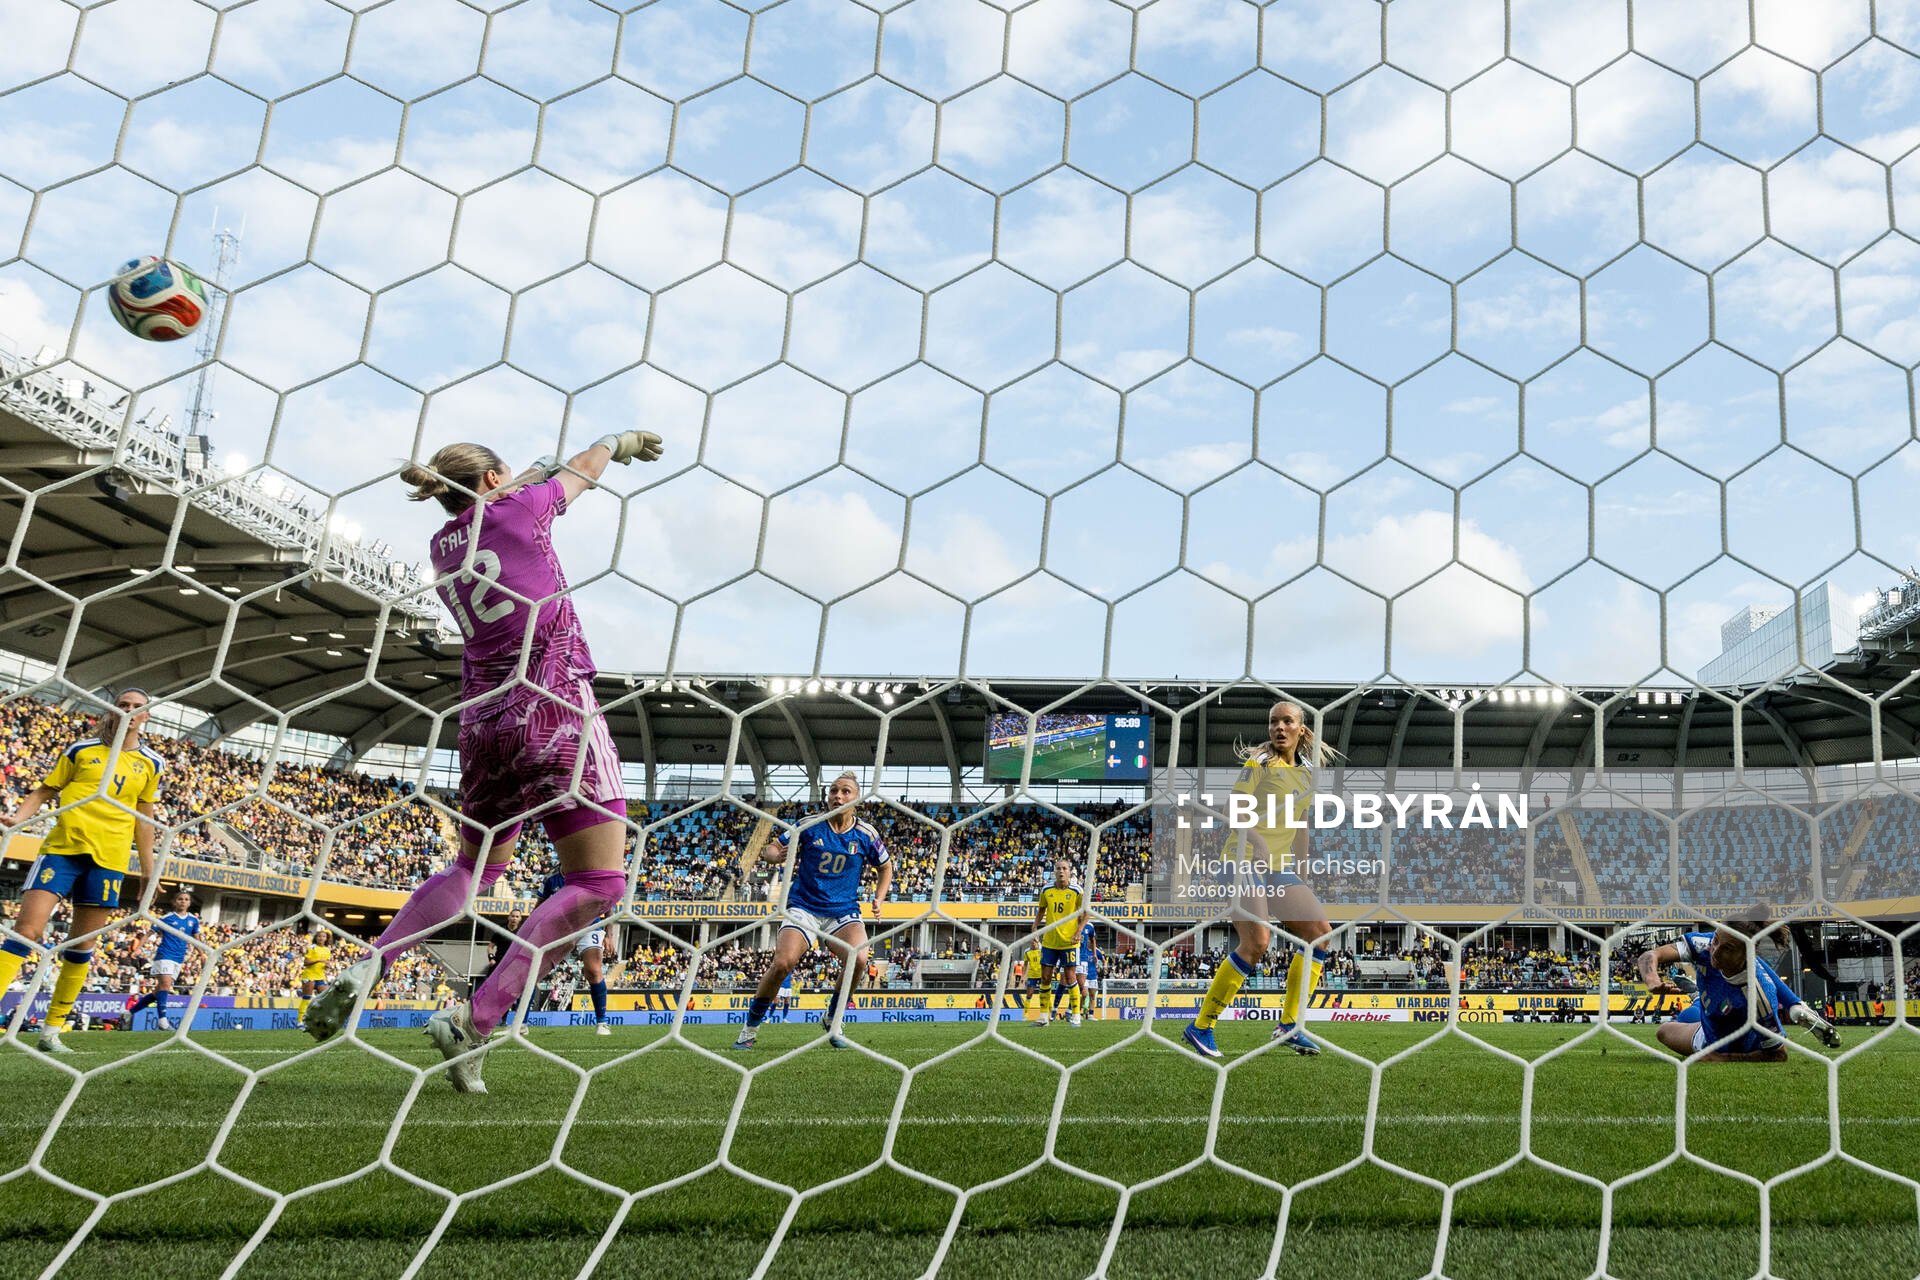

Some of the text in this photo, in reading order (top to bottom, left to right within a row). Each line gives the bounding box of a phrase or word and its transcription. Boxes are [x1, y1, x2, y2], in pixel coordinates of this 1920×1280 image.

[437, 549, 515, 639] 12
[819, 852, 846, 874] 20
[1054, 902, 1065, 913] 16
[591, 933, 599, 945] 9
[1066, 951, 1076, 963] 16
[83, 1001, 128, 1013] EUROPEA
[730, 997, 741, 1008] VI
[858, 997, 870, 1008] VI
[1396, 997, 1406, 1008] VI
[1518, 997, 1528, 1008] VI
[211, 1012, 253, 1030] Folksam
[569, 1013, 624, 1026] Folkam
[650, 1013, 702, 1025] Folkam
[882, 1011, 935, 1023] Folksam
[958, 1011, 1011, 1022] Folksm
[1330, 1011, 1392, 1022] Interbus
